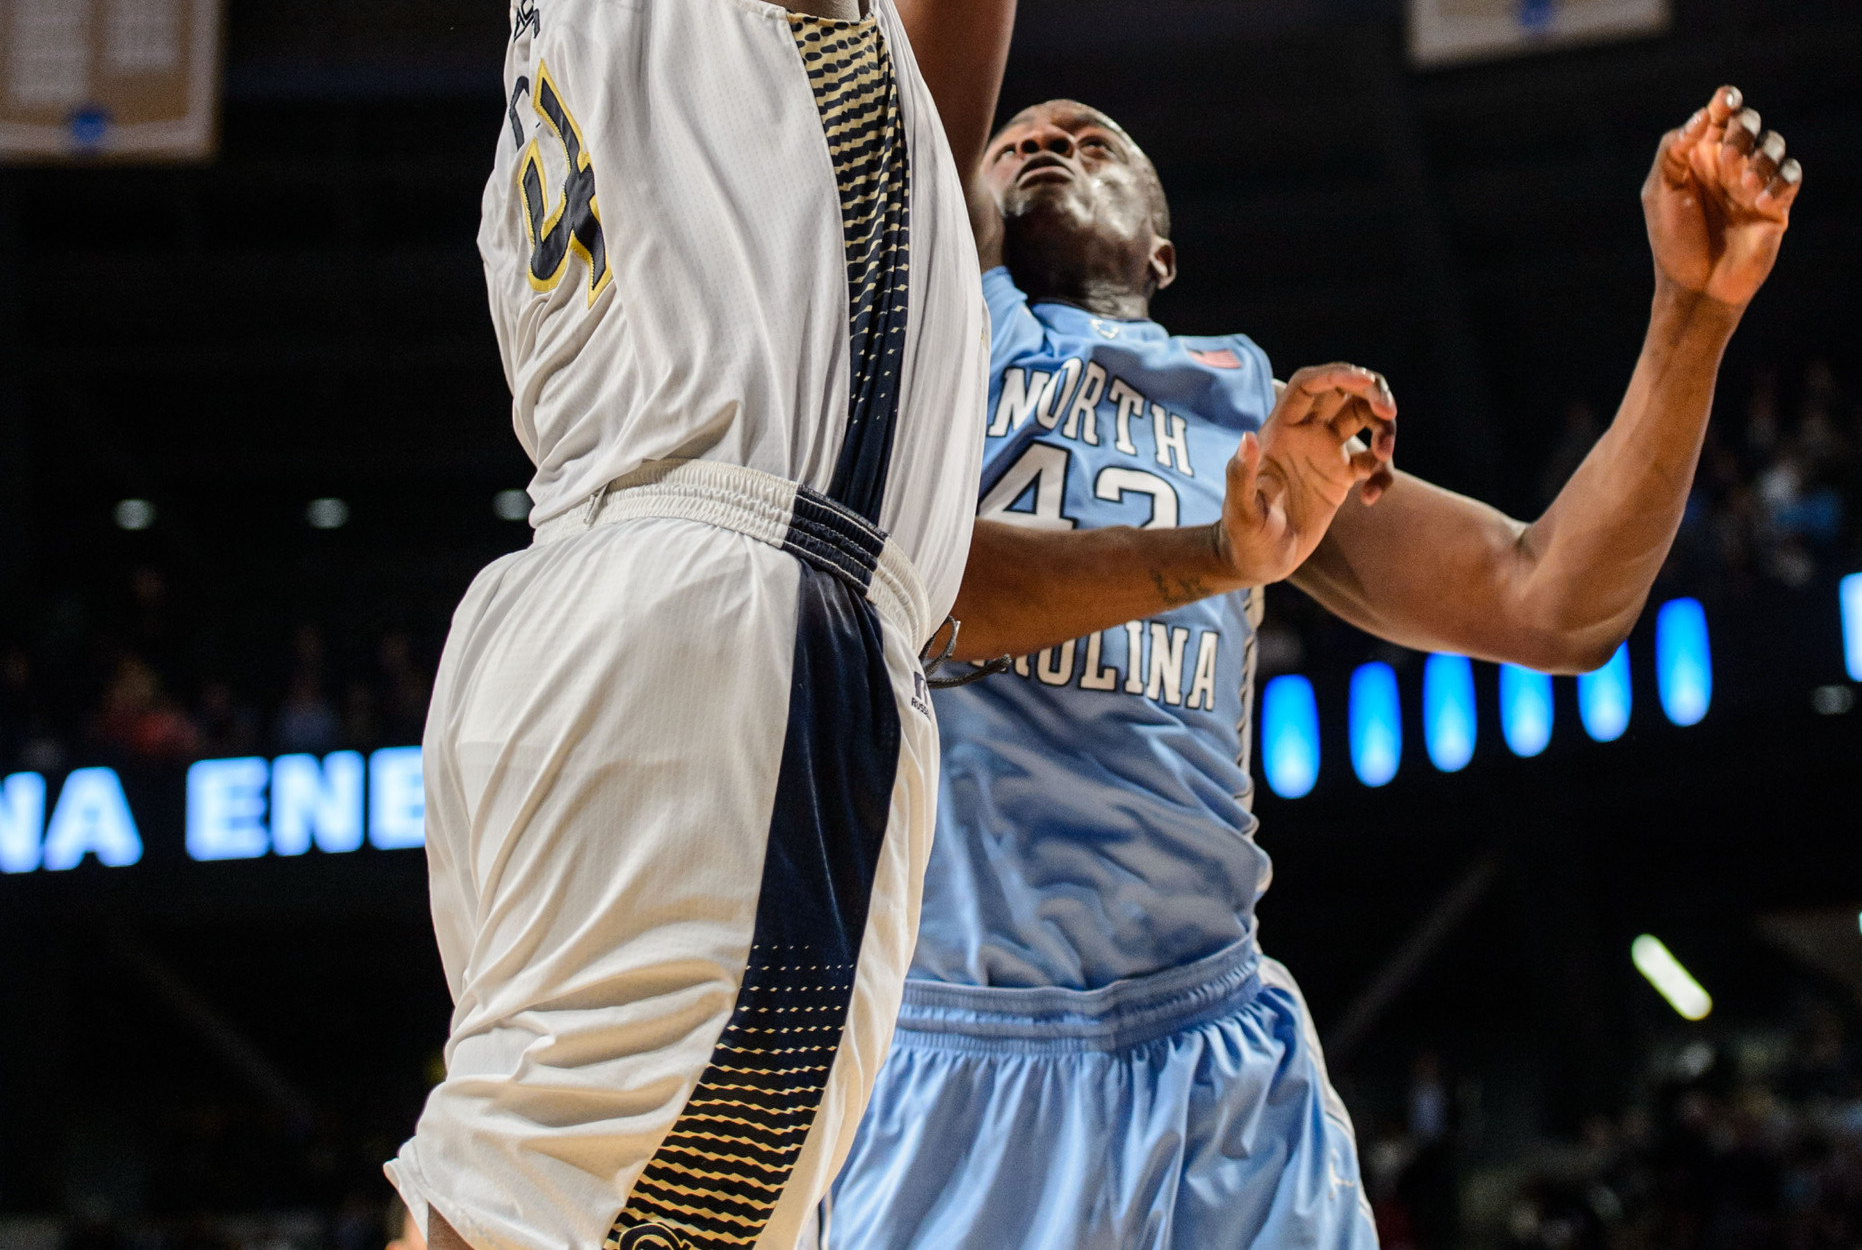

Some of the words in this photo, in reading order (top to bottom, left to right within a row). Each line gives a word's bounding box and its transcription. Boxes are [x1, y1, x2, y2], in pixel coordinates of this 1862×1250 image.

[988, 357, 1195, 479] NORTH
[976, 439, 1181, 530] 42
[970, 618, 1220, 712] OLINA
[185, 746, 426, 862] ENE
